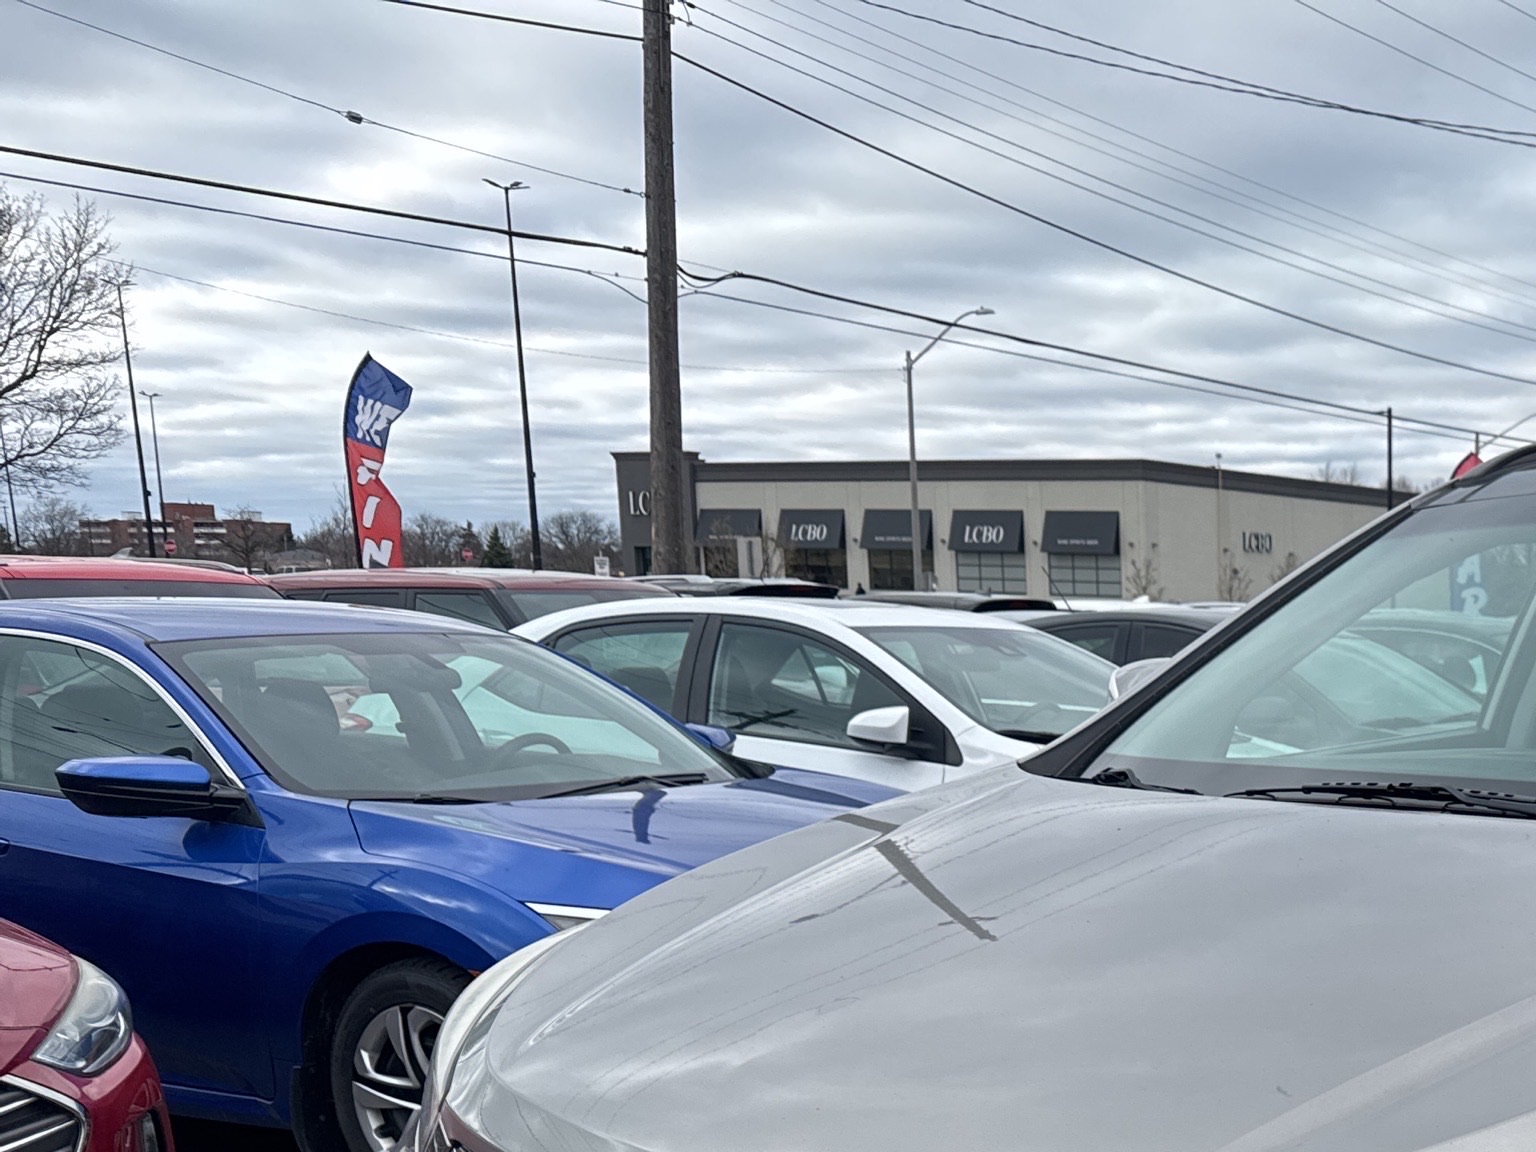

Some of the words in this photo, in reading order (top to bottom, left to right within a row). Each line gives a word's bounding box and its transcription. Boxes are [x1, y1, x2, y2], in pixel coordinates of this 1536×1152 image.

[790, 523, 828, 541] LCBO
[964, 525, 1004, 544] LCBO
[1242, 531, 1272, 554] LCBO
